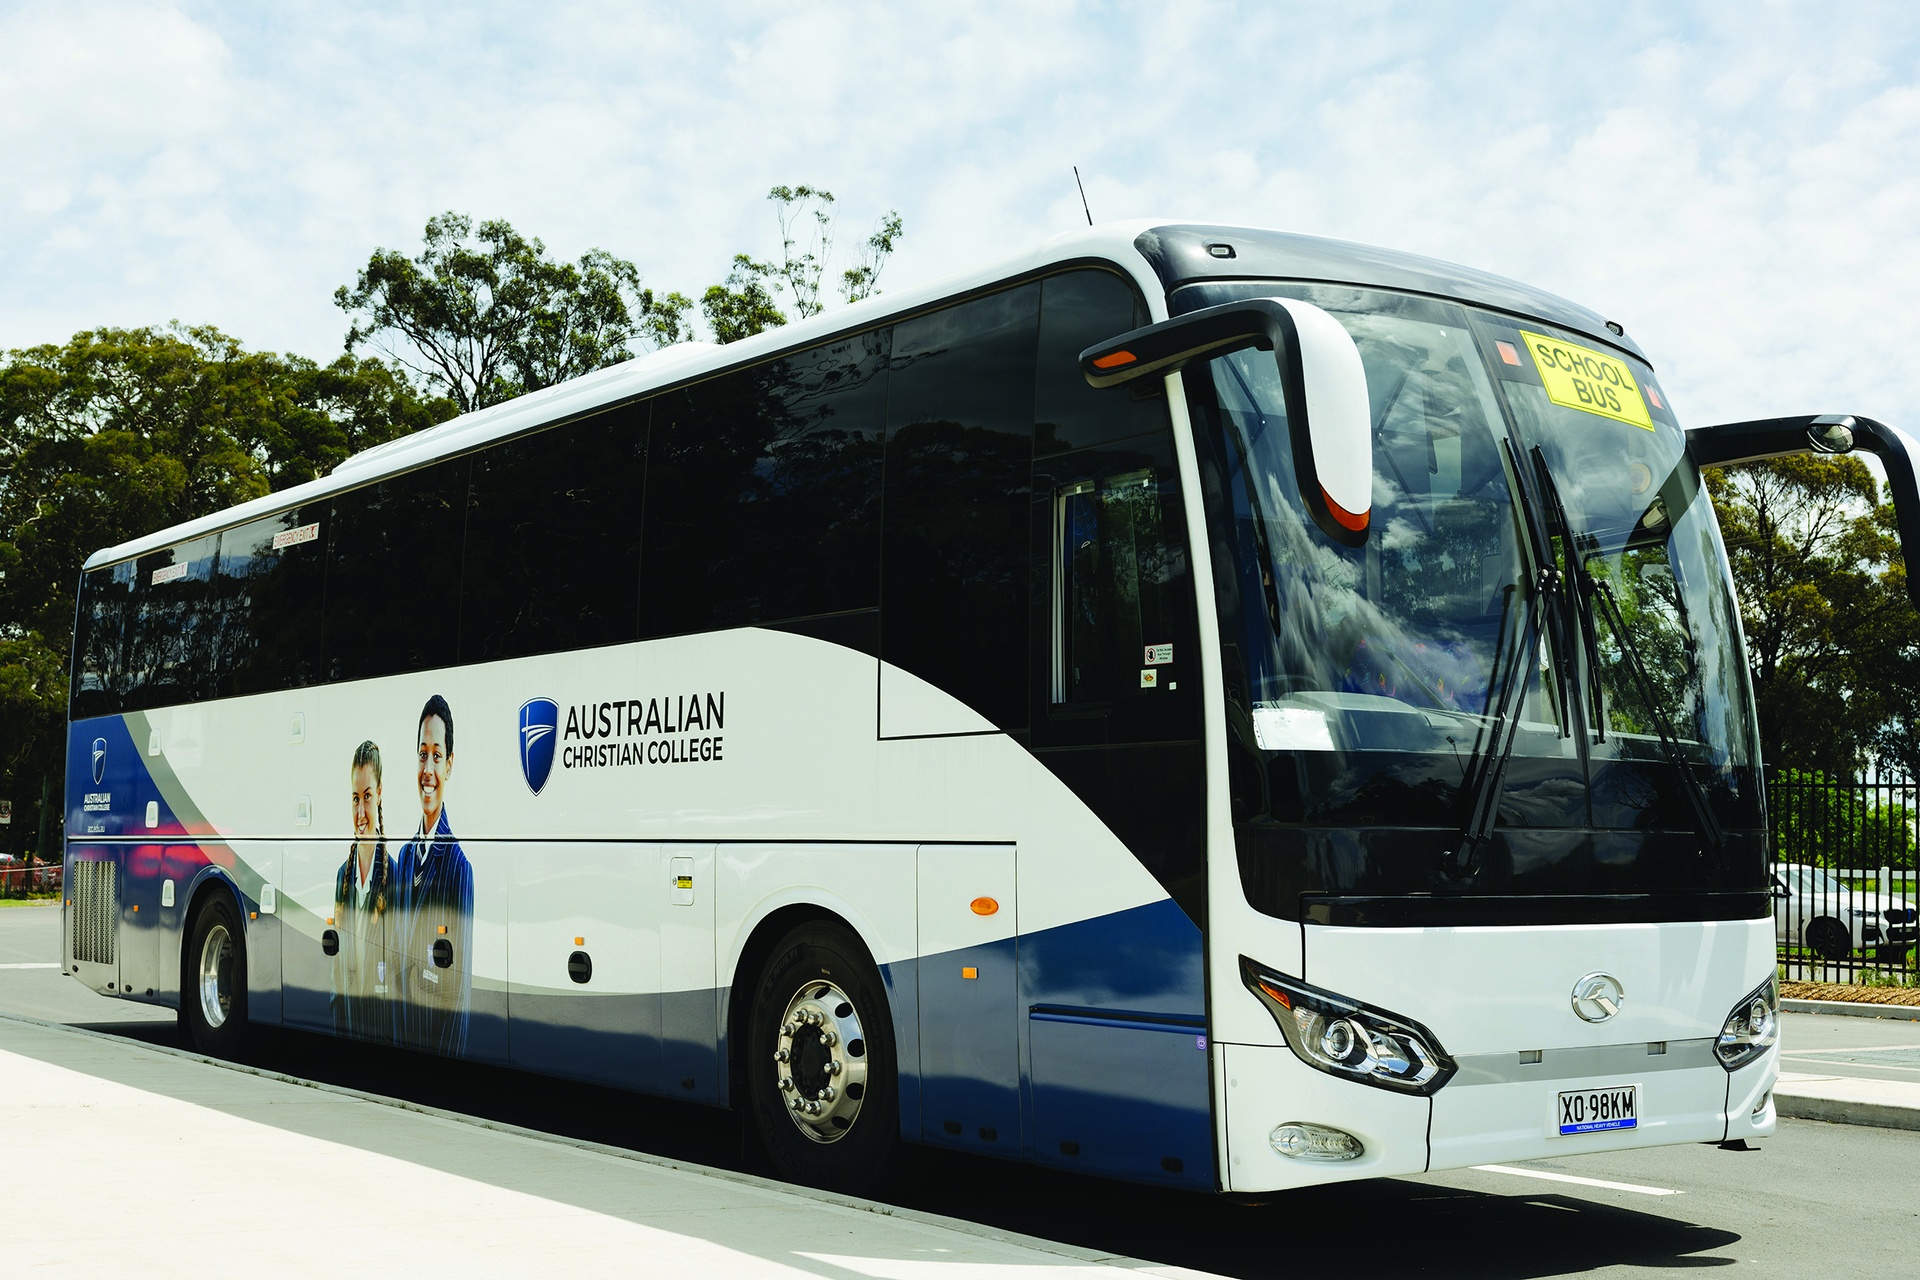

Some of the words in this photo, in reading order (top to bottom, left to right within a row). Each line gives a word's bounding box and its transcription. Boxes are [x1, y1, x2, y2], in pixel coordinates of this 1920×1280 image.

[1536, 343, 1634, 391] SCHOOL
[1571, 377, 1622, 413] BUS
[563, 691, 724, 741] AUSTRALIAN
[563, 741, 644, 769] CHRISTIAN
[647, 736, 723, 765] COLLEGE
[84, 792, 111, 804] AUSTRALIAN
